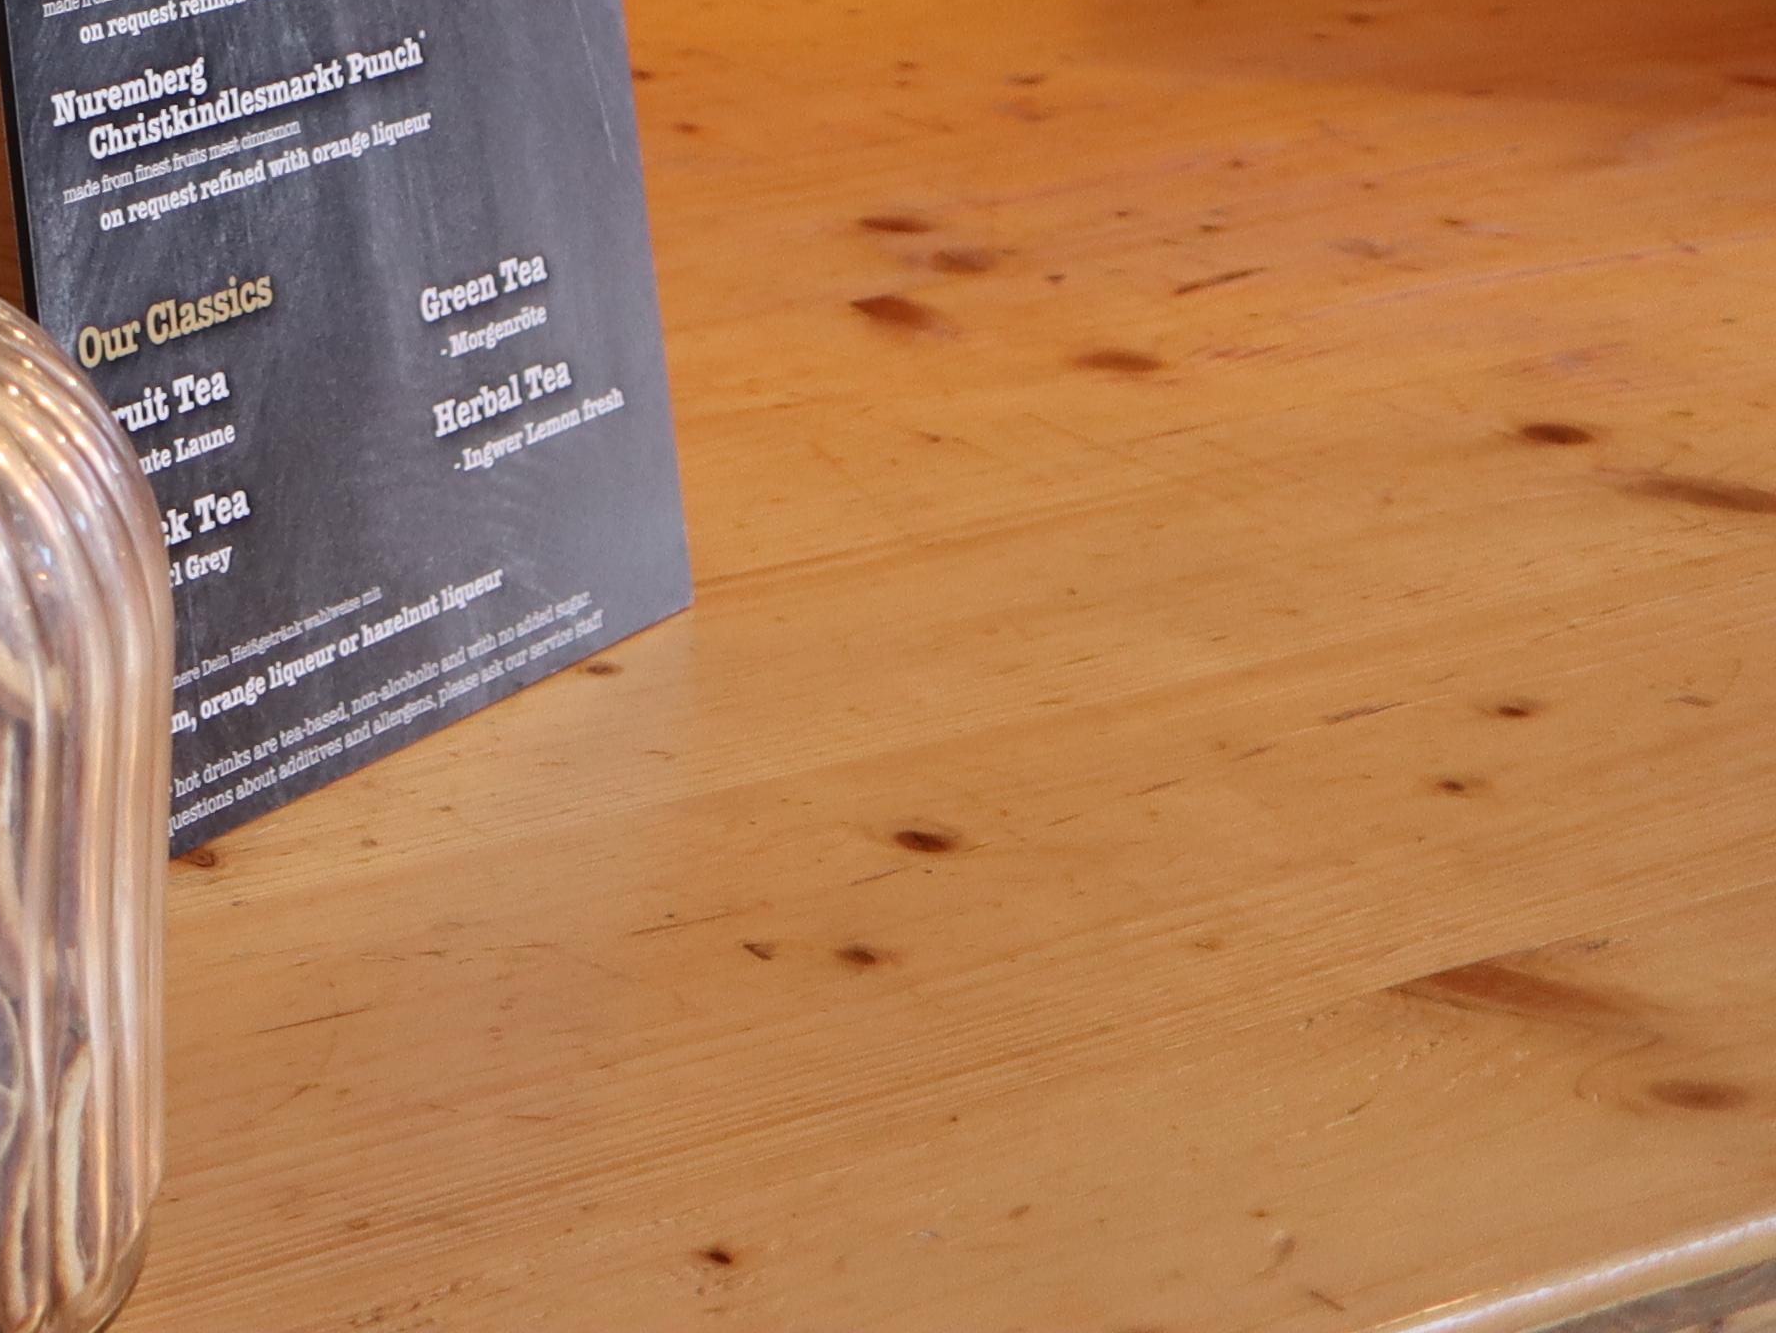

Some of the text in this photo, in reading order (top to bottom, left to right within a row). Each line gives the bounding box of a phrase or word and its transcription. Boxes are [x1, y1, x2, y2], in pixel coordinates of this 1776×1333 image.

[51, 56, 207, 127] Nuremberg
[90, 59, 344, 160] Christkindlesmarkt
[79, 275, 272, 373] Our Classics
[421, 256, 547, 322] Green Tea
[450, 305, 547, 358] Morgenröte
[110, 371, 229, 440] ruit Tea
[433, 362, 571, 438] Herbal Tea
[462, 388, 625, 471] Ingwer Lemon fresh
[174, 424, 235, 463] Laune
[194, 489, 251, 533] Tea
[185, 545, 233, 583] Grey
[200, 568, 503, 719] orange liqueur or hazelnut liqueur
[174, 604, 554, 798] hot drinks are tea-based, non-alcoholic and with no added
